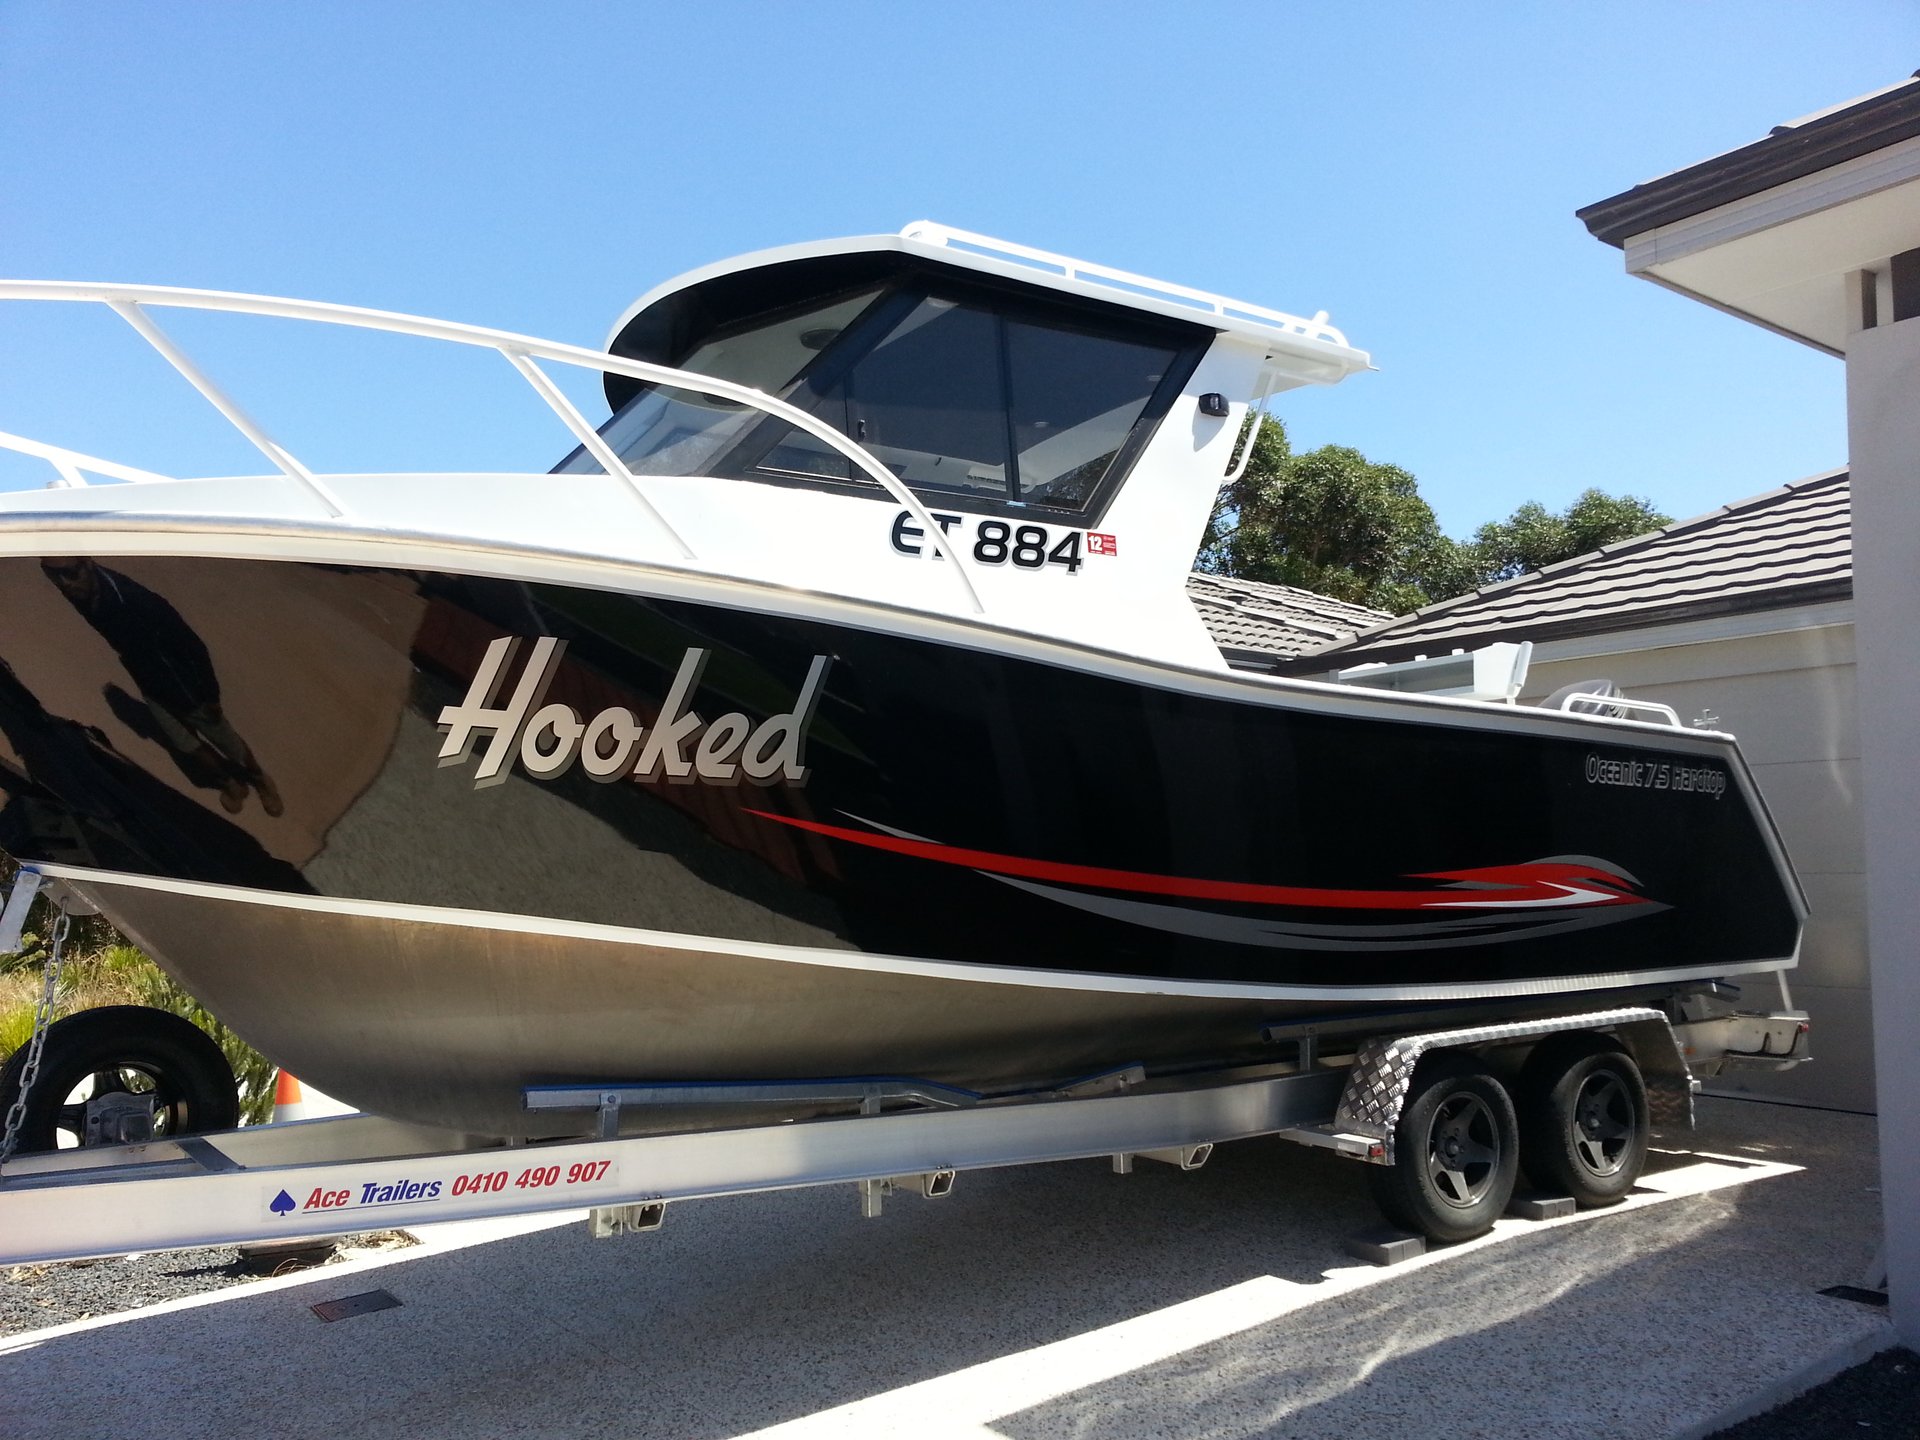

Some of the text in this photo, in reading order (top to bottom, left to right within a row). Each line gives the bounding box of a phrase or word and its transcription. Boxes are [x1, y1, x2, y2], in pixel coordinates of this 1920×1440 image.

[972, 520, 1084, 576] 884
[1088, 535, 1103, 551] 12
[437, 635, 834, 790] Hooked
[1585, 752, 1643, 788] Oceanic
[1672, 766, 1726, 800] Hardtop
[303, 1160, 612, 1210] Ace Trailers 0410 490 907
